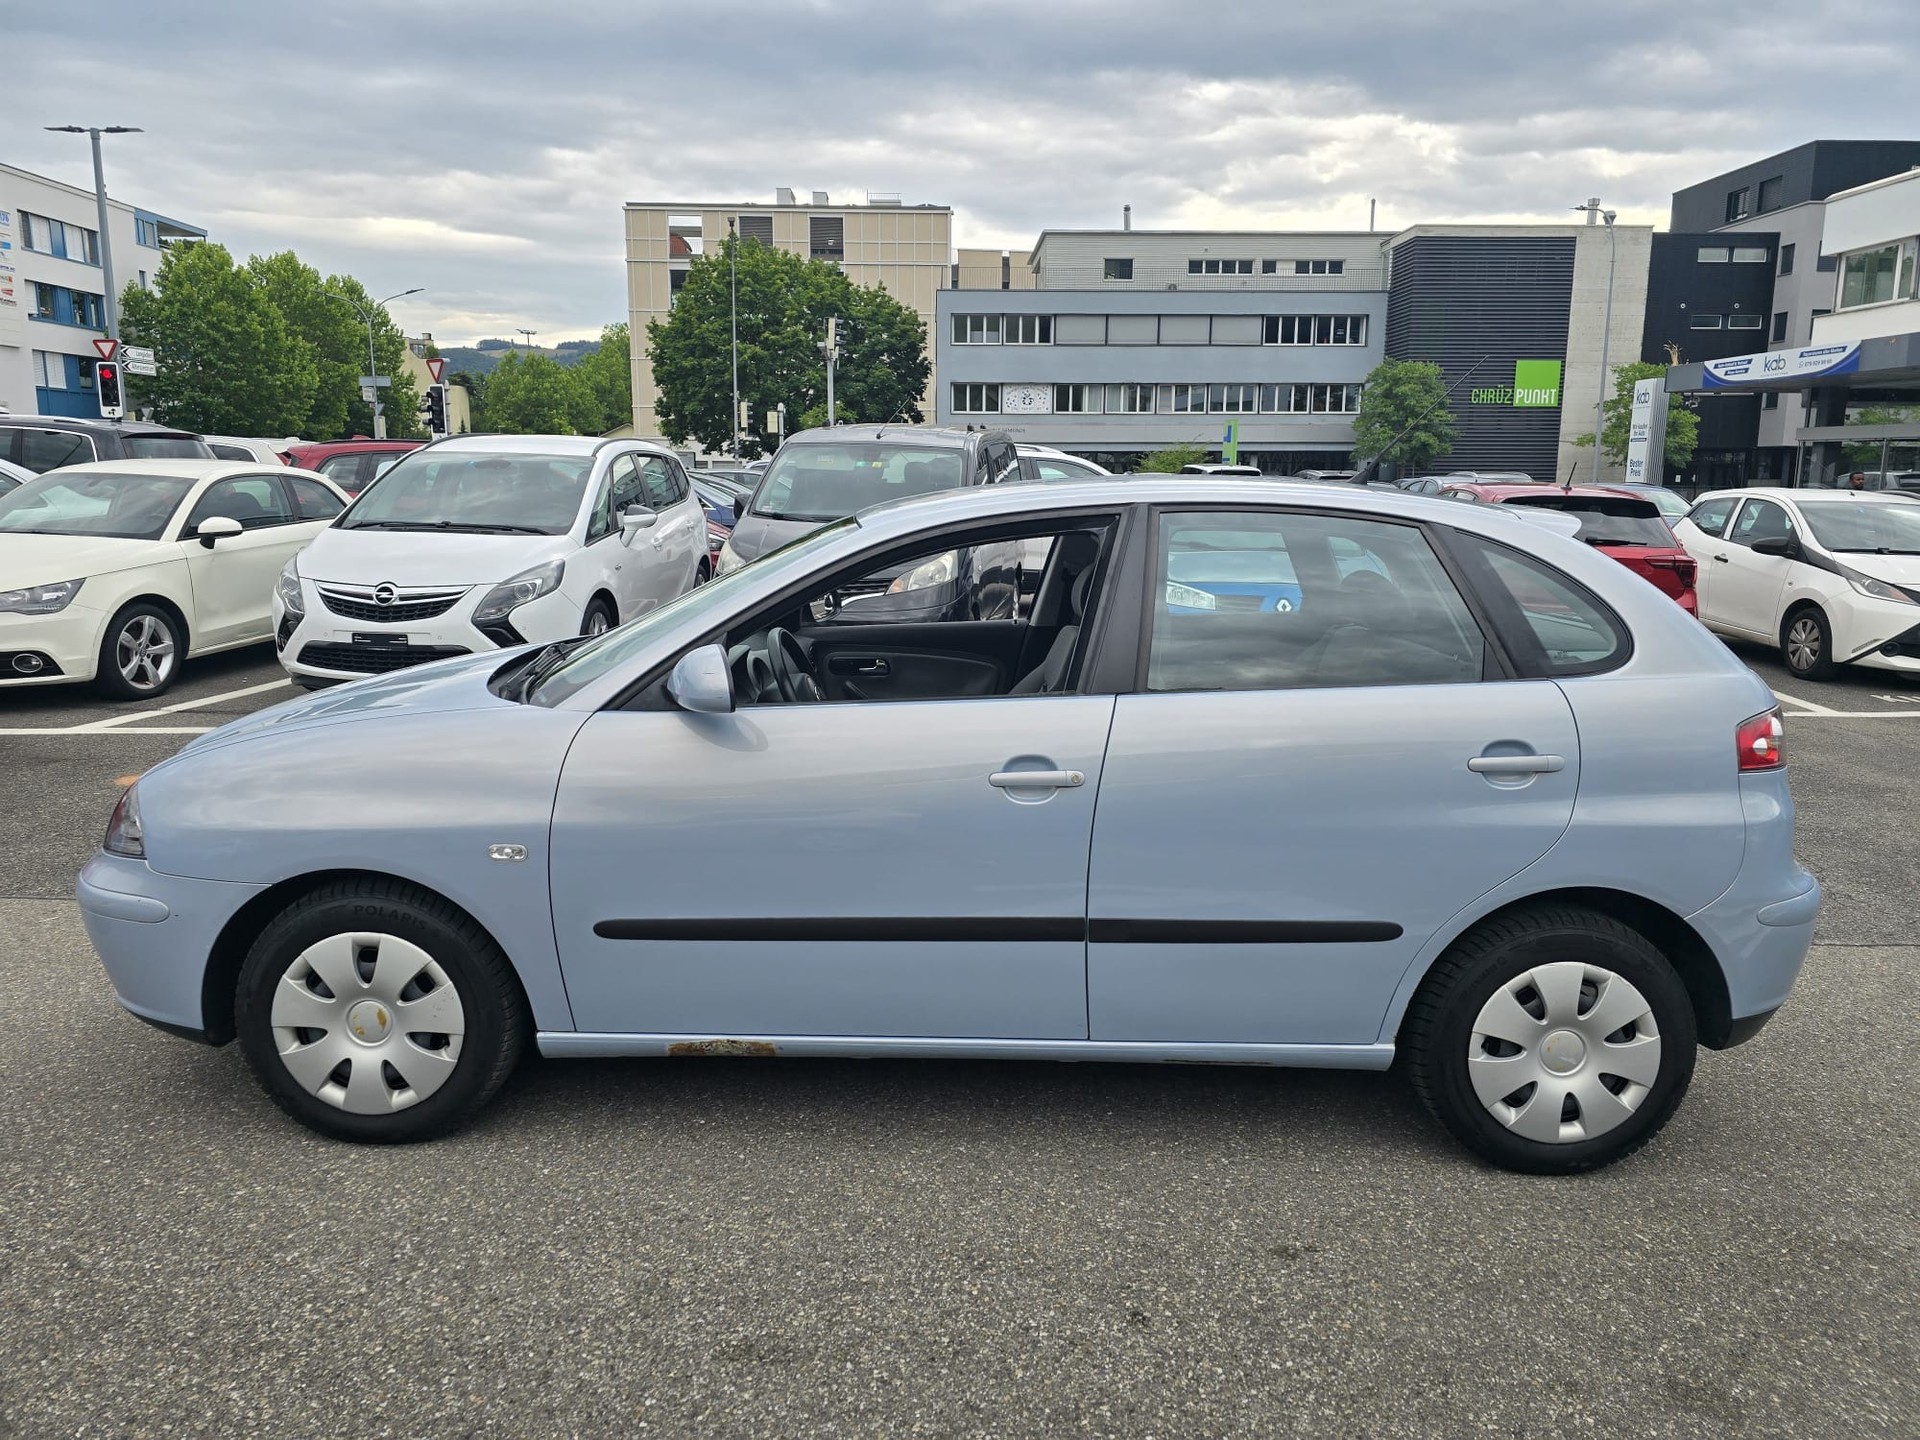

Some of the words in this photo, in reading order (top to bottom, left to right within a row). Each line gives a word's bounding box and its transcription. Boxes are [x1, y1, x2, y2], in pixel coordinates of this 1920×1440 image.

[1763, 354, 1786, 372] kab
[1471, 384, 1513, 404] CHRÜZ
[1515, 388, 1557, 404] PUNKT
[1636, 387, 1650, 404] kab
[1629, 458, 1643, 468] Bester
[1629, 468, 1641, 477] Preis
[354, 904, 427, 929] POLARIS
